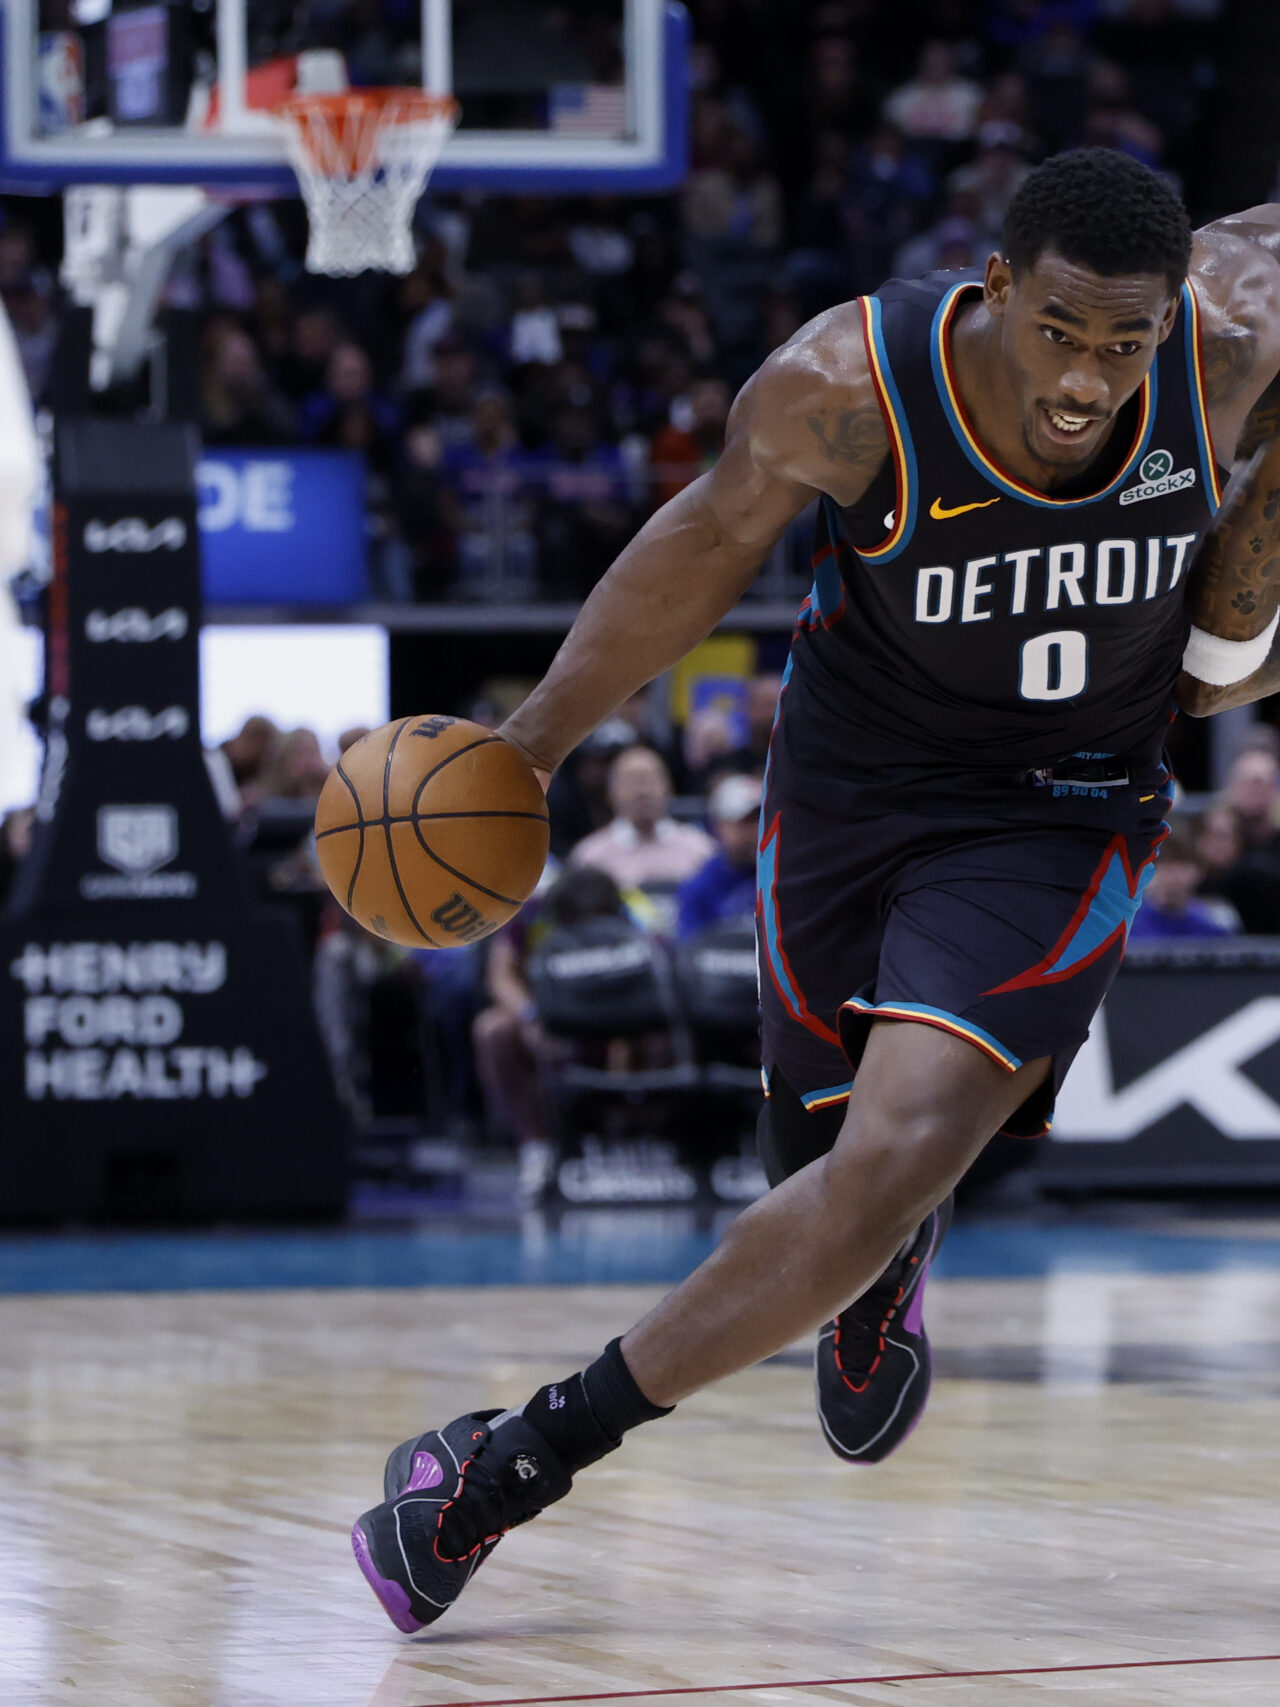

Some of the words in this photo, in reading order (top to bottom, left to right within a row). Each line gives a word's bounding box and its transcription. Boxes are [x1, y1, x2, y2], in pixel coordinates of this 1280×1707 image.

[914, 531, 1197, 623] DETROIT
[1017, 630, 1089, 701] 0
[1052, 786, 1069, 798] 89
[1090, 787, 1109, 799] 04
[10, 942, 228, 994] HENRY
[24, 995, 184, 1047] FORD
[25, 1047, 268, 1100] HEALTH
